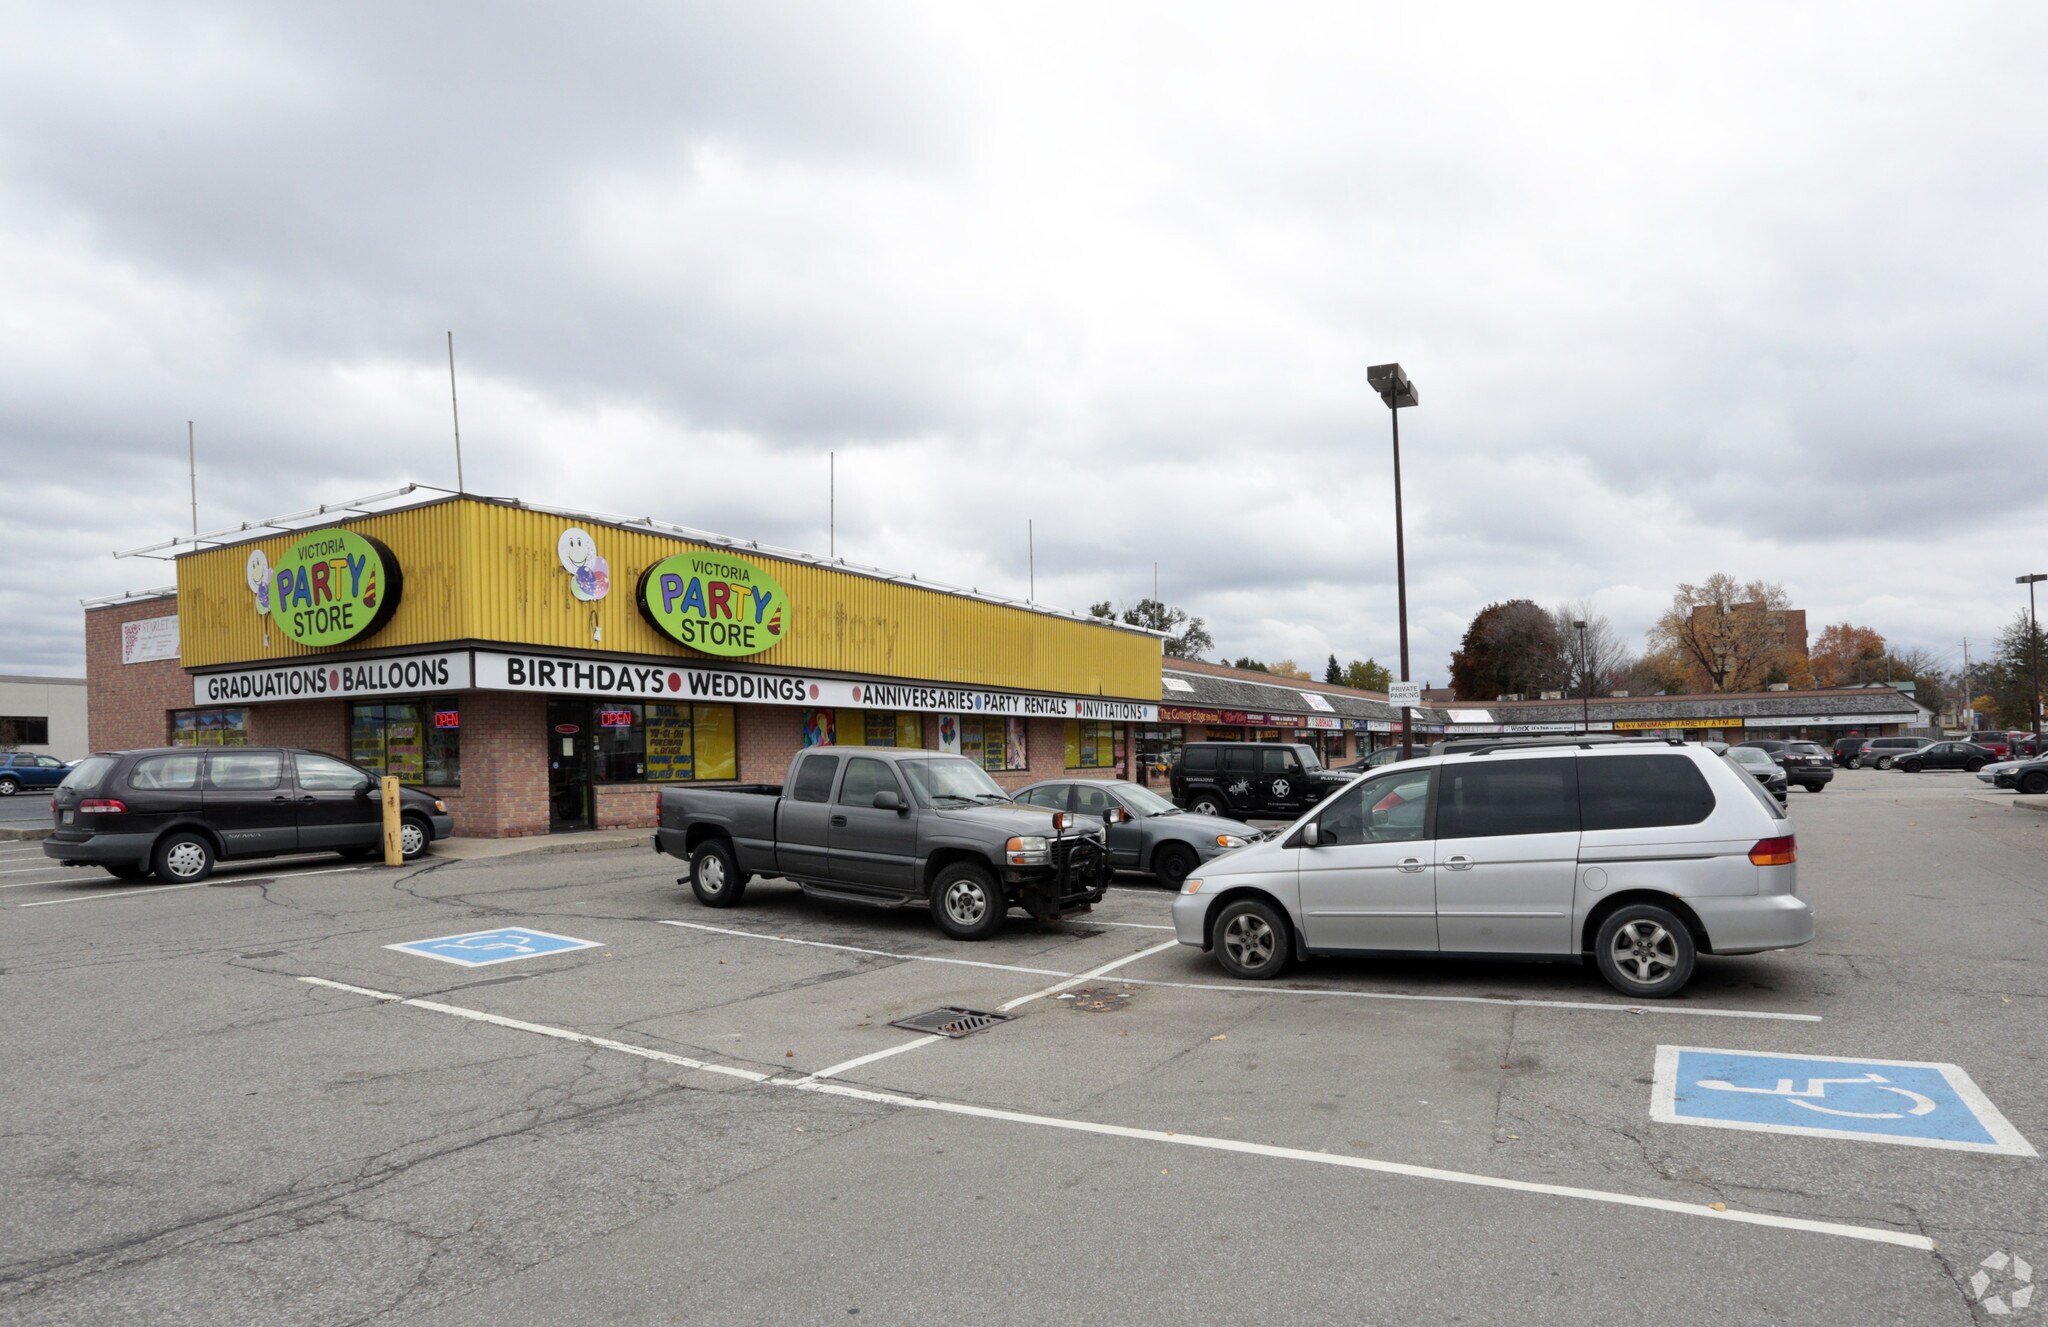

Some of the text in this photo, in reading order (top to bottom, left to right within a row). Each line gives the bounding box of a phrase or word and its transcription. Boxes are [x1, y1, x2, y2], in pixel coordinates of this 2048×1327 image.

[297, 537, 346, 561] VICTORIA
[277, 553, 367, 612] PARTY
[691, 559, 751, 583] VICTORIA
[659, 573, 772, 624] PARTY
[293, 603, 354, 637] STORE
[681, 618, 756, 648] STORE
[207, 657, 450, 701] GRADUATIONS BALLOONS
[507, 657, 806, 701] BIRTHDAYS WEDDINGS
[862, 684, 1143, 721] ANNIVERSARIES PARTY RENTALS INVITATIONS
[1159, 708, 1171, 720] The
[1171, 708, 1192, 723] Cutting
[435, 712, 459, 727] OPEN
[601, 712, 632, 726] OPEN
[1637, 720, 1671, 728] MINIMART
[1675, 719, 1708, 727] VARIETY
[228, 832, 262, 840] SIENNA
